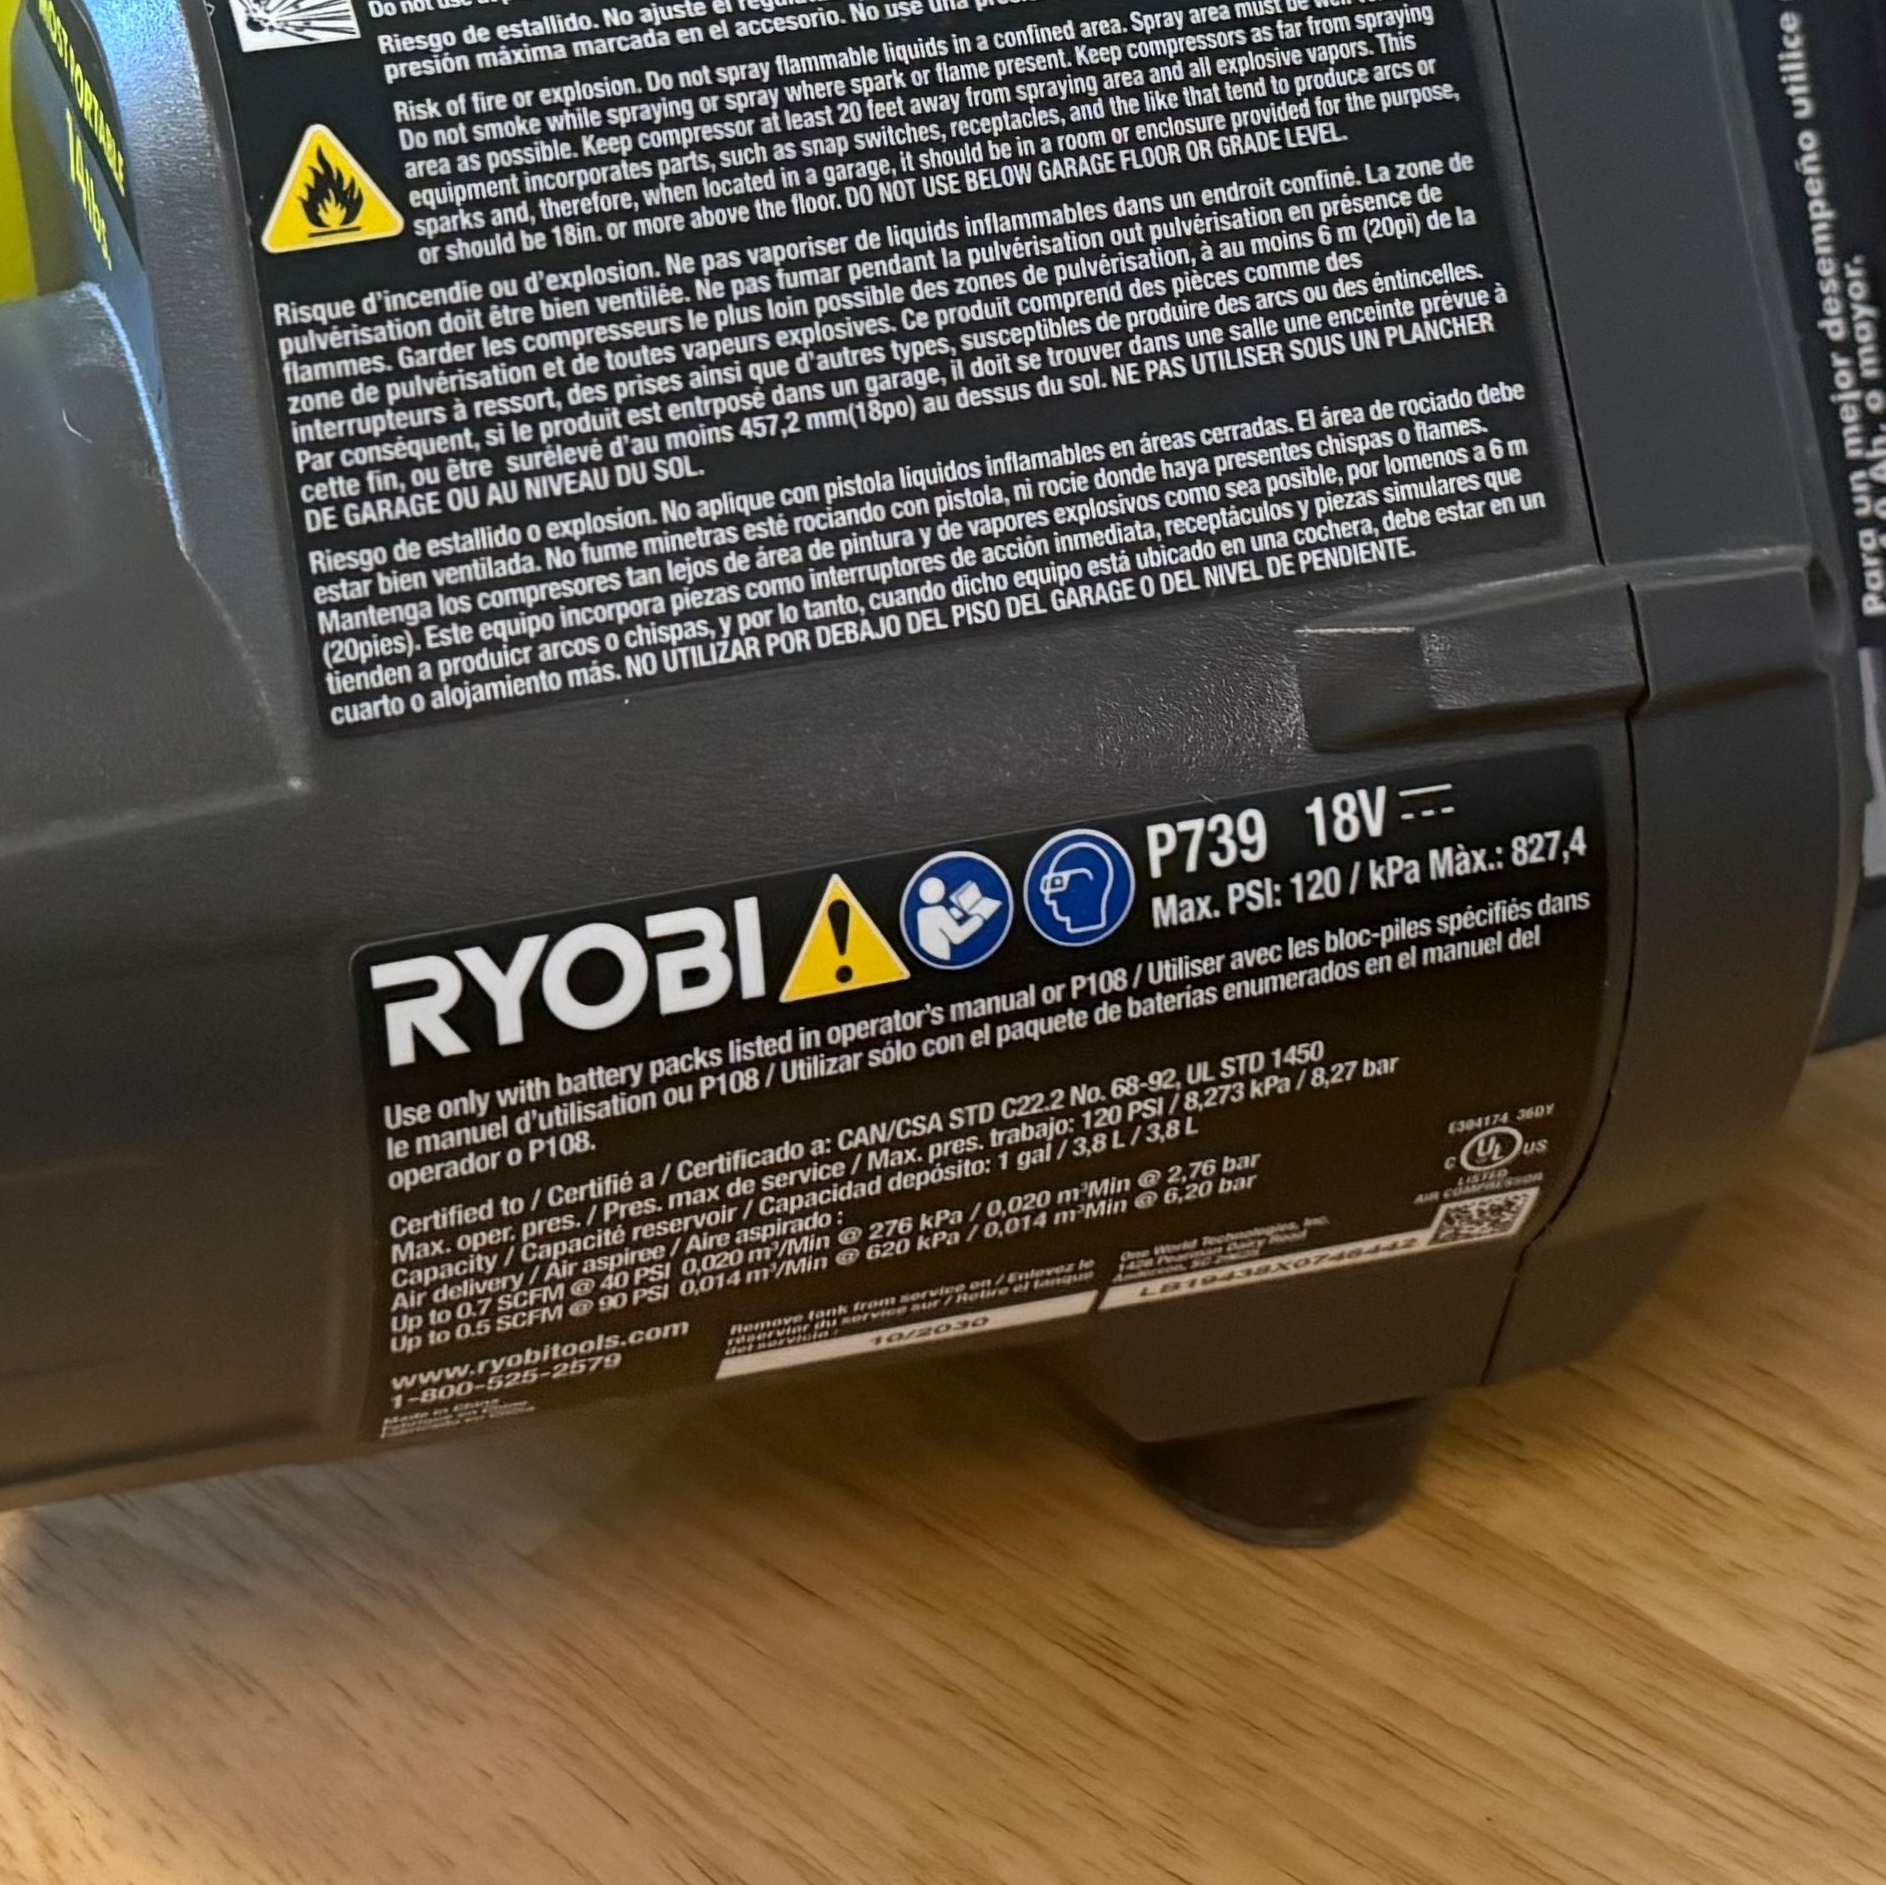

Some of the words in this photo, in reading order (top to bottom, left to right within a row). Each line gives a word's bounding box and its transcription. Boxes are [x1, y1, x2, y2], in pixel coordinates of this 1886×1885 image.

[366, 0, 398, 19] Do
[392, 96, 443, 124] Risk
[444, 92, 467, 118] of
[470, 90, 509, 115] fire
[510, 89, 535, 110] or
[537, 76, 644, 108] explosion.
[643, 69, 675, 93] Do
[676, 64, 714, 89] not
[714, 60, 771, 88] spray
[773, 44, 880, 77] flammable
[881, 35, 950, 66] liquids
[951, 35, 973, 55] in
[975, 33, 990, 53] a
[992, 18, 1077, 50] confined
[1078, 17, 1129, 40] area.
[1128, 9, 1185, 36] Spray
[1187, 3, 1232, 26] area
[1777, 11, 1815, 120] utilice
[1794, 128, 1850, 342] desempeño
[1846, 252, 1879, 379] mayor.
[1829, 353, 1863, 461] mejor
[1864, 391, 1886, 413] o
[303, 505, 340, 534] DE
[342, 490, 443, 528] GARAGE
[445, 484, 481, 513] OU
[485, 478, 520, 507] AU
[522, 466, 611, 501] NIVEAU
[613, 460, 649, 489] DU
[651, 455, 706, 483] SOL.
[1852, 472, 1874, 518] un
[1854, 531, 1886, 617] Para
[329, 694, 406, 726] cuarto
[409, 692, 427, 714] o
[429, 668, 564, 711] alojamiento
[565, 662, 623, 689] más.
[623, 651, 659, 680] NO
[660, 635, 763, 673] UTILIZAR
[764, 627, 813, 657] POR
[813, 613, 903, 649] DEBAJO
[904, 606, 950, 635] DEL
[950, 597, 1002, 628] PISO
[1003, 591, 1049, 619] DEL
[1049, 576, 1138, 612] GARAGE
[1138, 573, 1156, 598] O
[1158, 567, 1202, 596] DEL
[1201, 558, 1265, 589] NIVEL
[1264, 552, 1297, 579] DE
[1296, 534, 1418, 575] PENDIENTE.
[1146, 809, 1268, 879] P739
[1305, 785, 1388, 848] 18V
[1151, 893, 1221, 929] Max.
[1226, 876, 1283, 916] PSI:
[1289, 865, 1342, 904] 120
[1348, 860, 1362, 896] /
[1368, 854, 1421, 891] kPa
[1510, 827, 1588, 868] 827,4
[370, 896, 767, 1068] RYOBI
[383, 1102, 433, 1131] Use
[436, 1088, 491, 1120] only
[494, 1075, 552, 1109] with
[555, 1061, 645, 1098] battery
[648, 1045, 724, 1085] packs
[727, 1028, 794, 1065] listed
[798, 1028, 822, 1051] in
[948, 982, 1037, 1023] manual
[1040, 982, 1067, 1006] or
[1069, 966, 1129, 1001] P108
[1131, 962, 1144, 990] /
[1146, 953, 1227, 986] Utiliser
[1229, 943, 1284, 971] avec
[1286, 935, 1321, 961] les
[1323, 916, 1433, 954] bloc-piles
[1435, 898, 1534, 938] spécifiés
[1536, 890, 1591, 917] dans
[387, 1150, 502, 1193] operador
[505, 1146, 524, 1168] o
[527, 1129, 597, 1164] P108.
[389, 1197, 495, 1238] Certified
[499, 1195, 526, 1217] to
[546, 1169, 635, 1208] Certifié
[638, 1170, 655, 1191] a
[675, 1139, 806, 1183] Certificado
[809, 1136, 832, 1158] a:
[836, 1111, 945, 1152] CAN/CSA
[948, 1100, 996, 1131] STD
[1000, 1087, 1066, 1121] C22.2
[1069, 1082, 1107, 1108] No.
[1109, 1067, 1182, 1100] 68-92,
[1185, 1060, 1216, 1086] UL
[1219, 1050, 1266, 1080] STD
[1270, 1039, 1325, 1069] 1450
[1523, 1139, 1549, 1155] US
[391, 1321, 691, 1391] www.ryobitools.com
[870, 1316, 990, 1348] 10/2030
[391, 1354, 623, 1410] 1-800-525-2579
